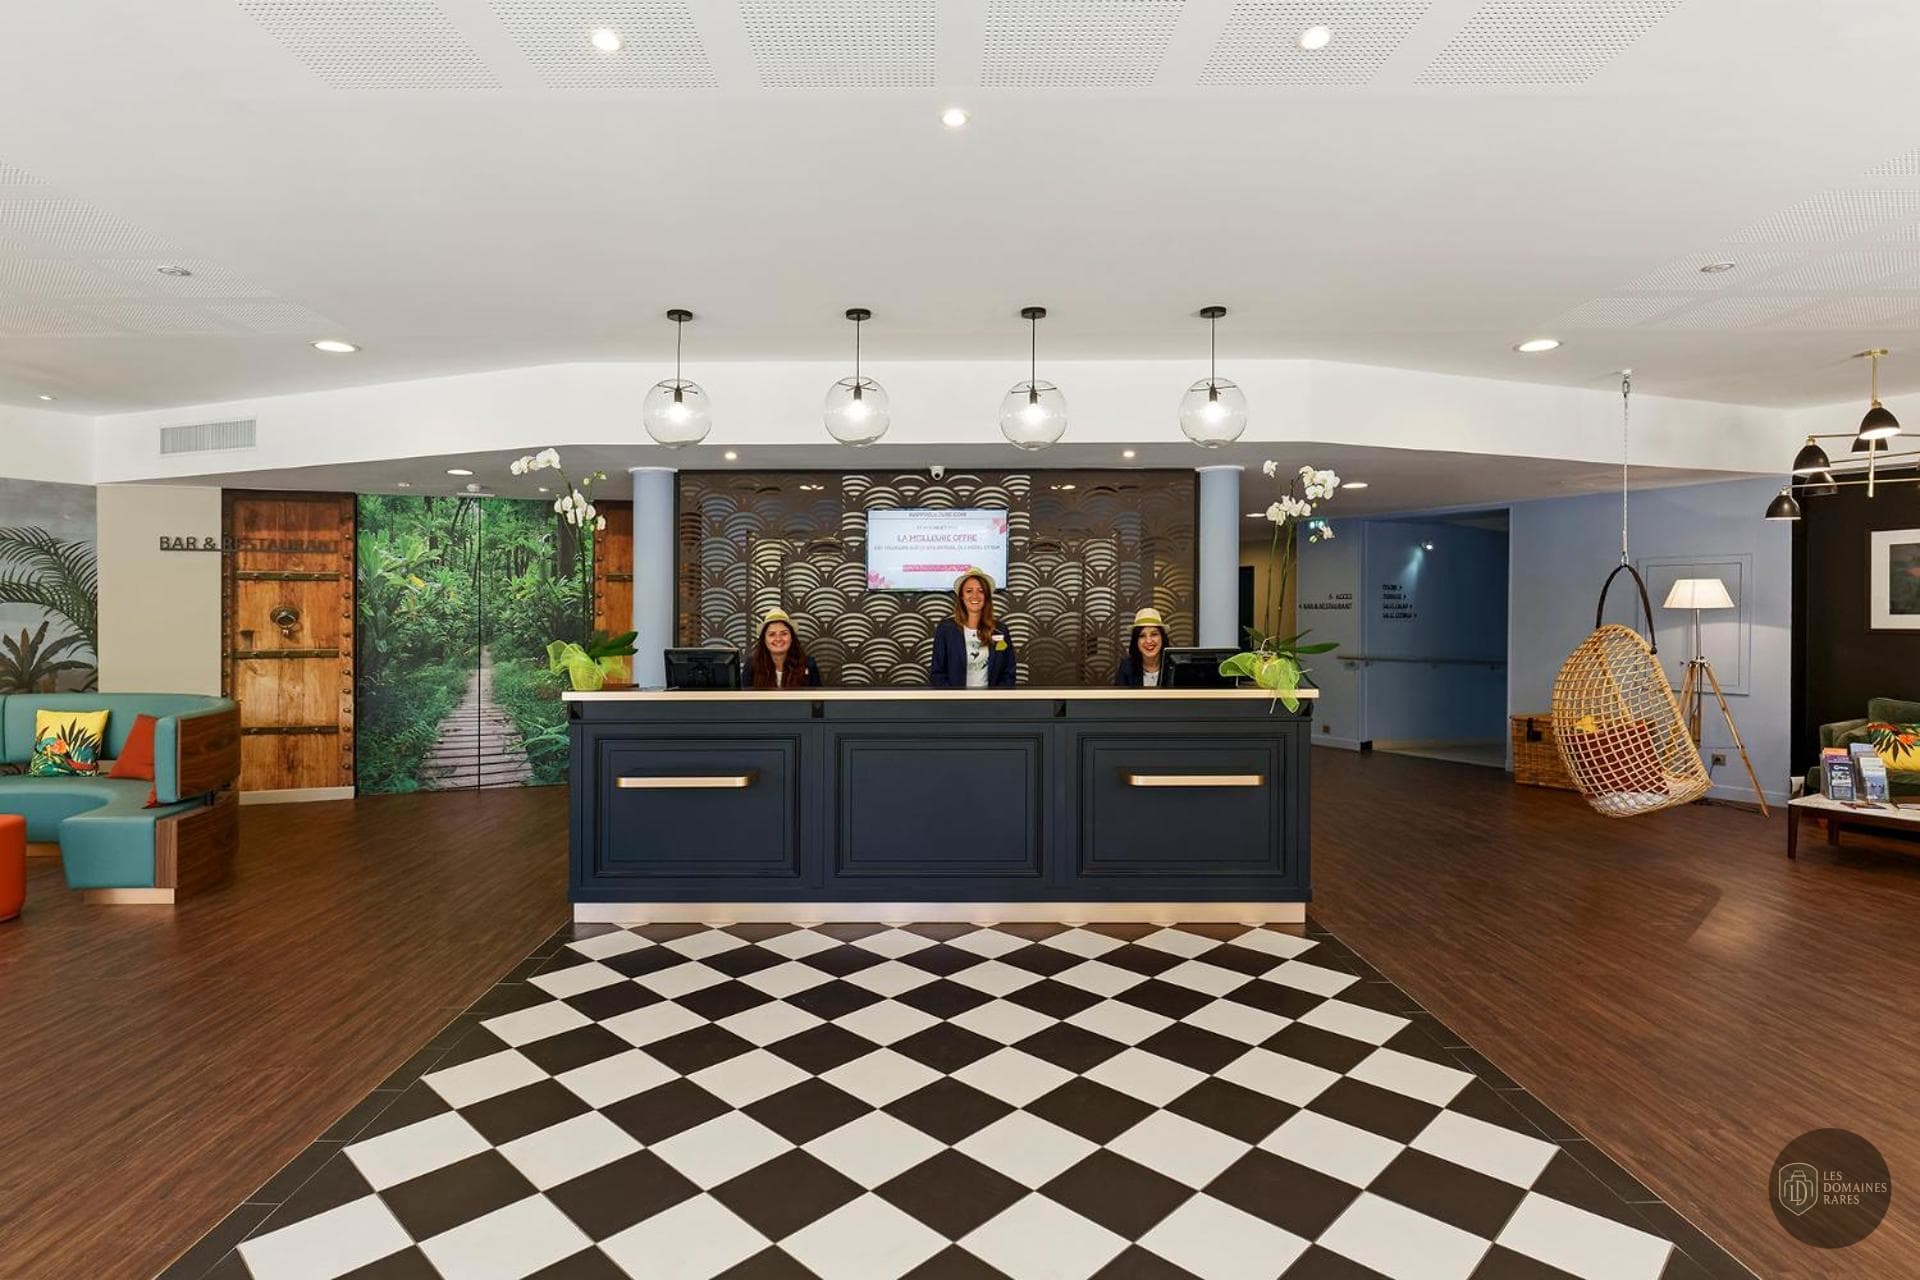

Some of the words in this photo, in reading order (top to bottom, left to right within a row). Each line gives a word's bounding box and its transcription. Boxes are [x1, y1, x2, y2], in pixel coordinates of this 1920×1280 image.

[160, 536, 197, 550] BAR
[203, 536, 216, 550] &
[222, 537, 339, 553] RESTAURANT
